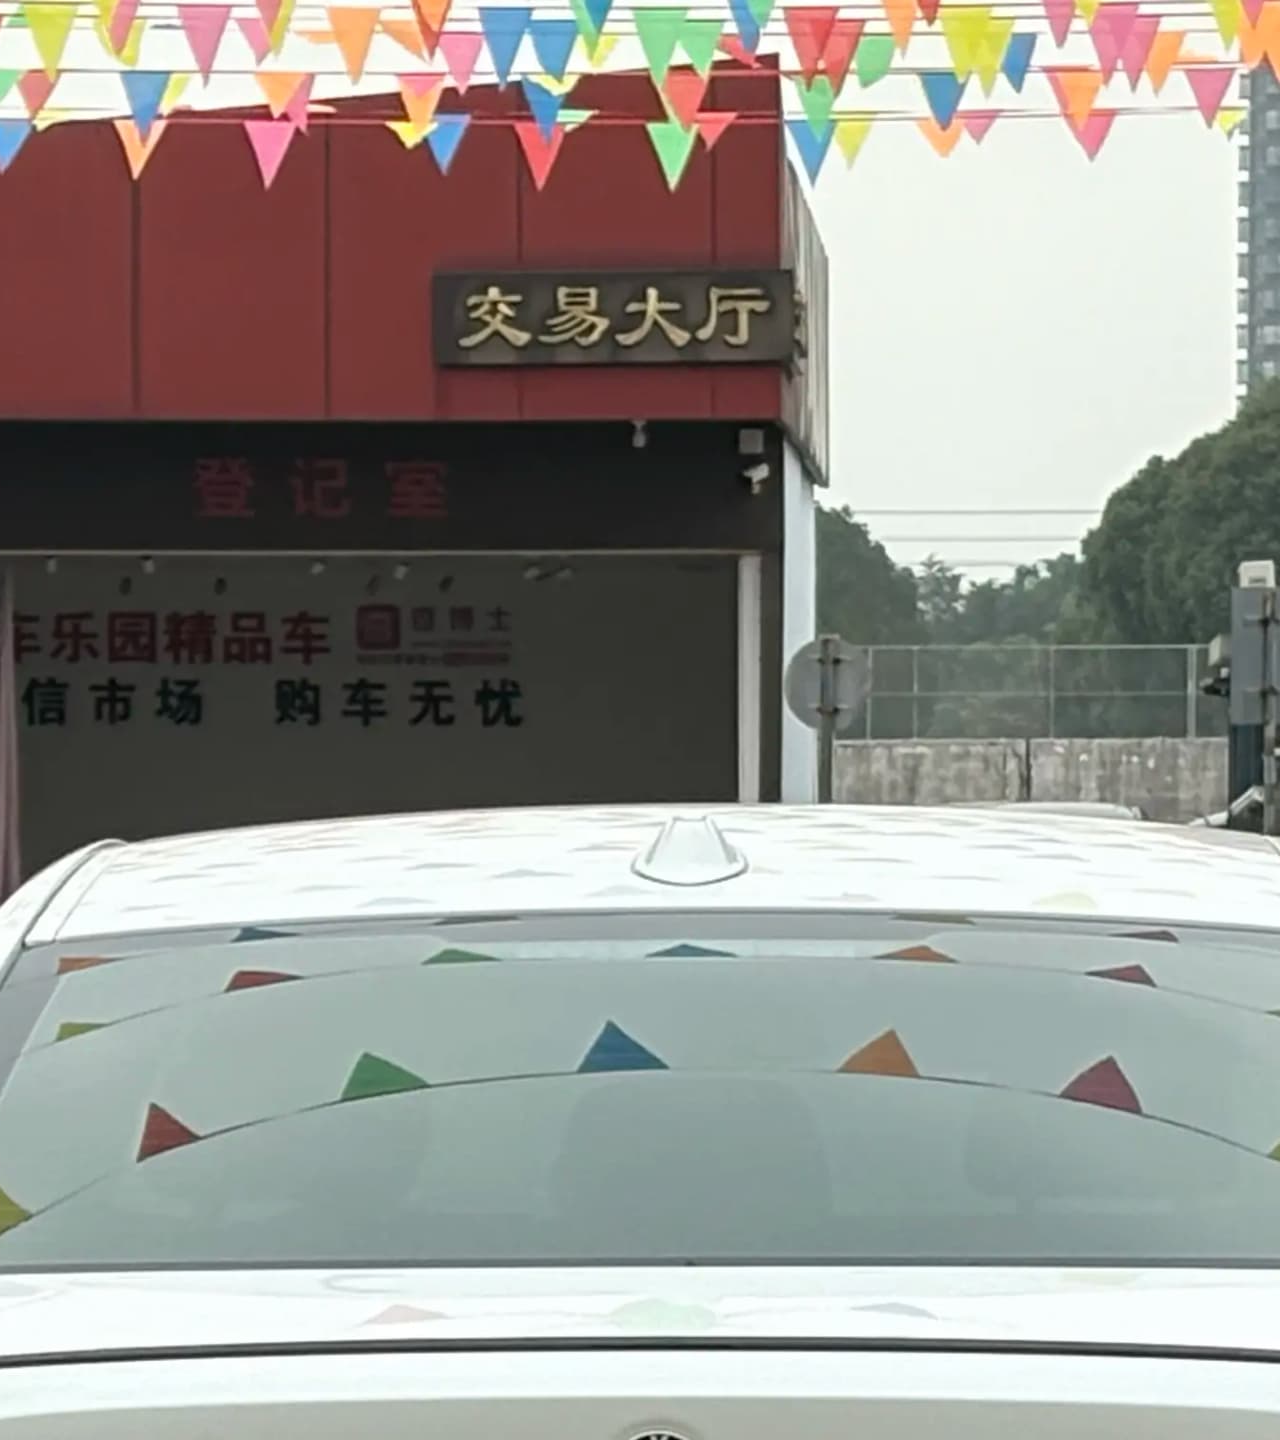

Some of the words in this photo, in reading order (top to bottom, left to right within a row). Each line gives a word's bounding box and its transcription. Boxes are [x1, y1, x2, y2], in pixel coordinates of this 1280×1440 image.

[458, 285, 771, 347] 交易大厅
[192, 456, 450, 519] 登记室
[21, 677, 204, 728] 信市场
[273, 676, 525, 728] 购车无忧
